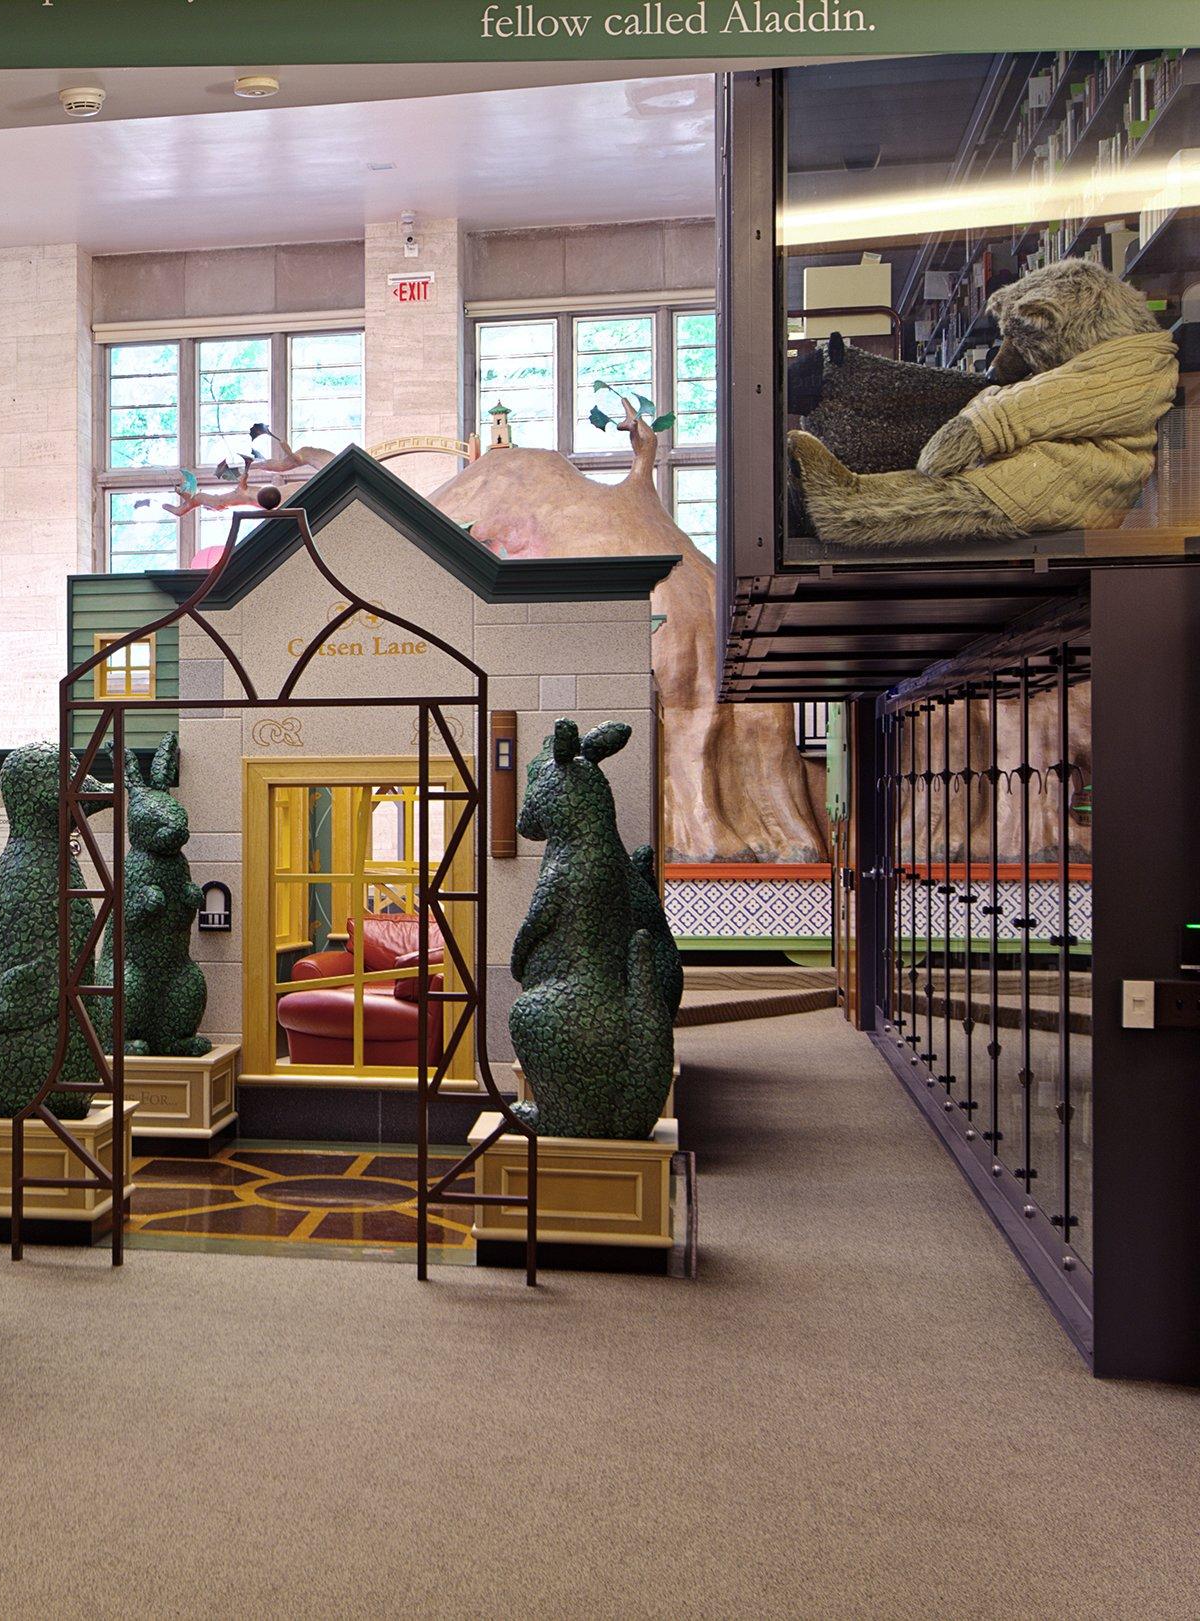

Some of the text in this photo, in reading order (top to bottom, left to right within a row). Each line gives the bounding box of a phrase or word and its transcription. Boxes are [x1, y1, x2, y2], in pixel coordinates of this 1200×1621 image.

[480, 0, 877, 38] fellow called Aladdin.
[399, 281, 429, 301] EXIT
[287, 636, 428, 658] Ctsen Lane
